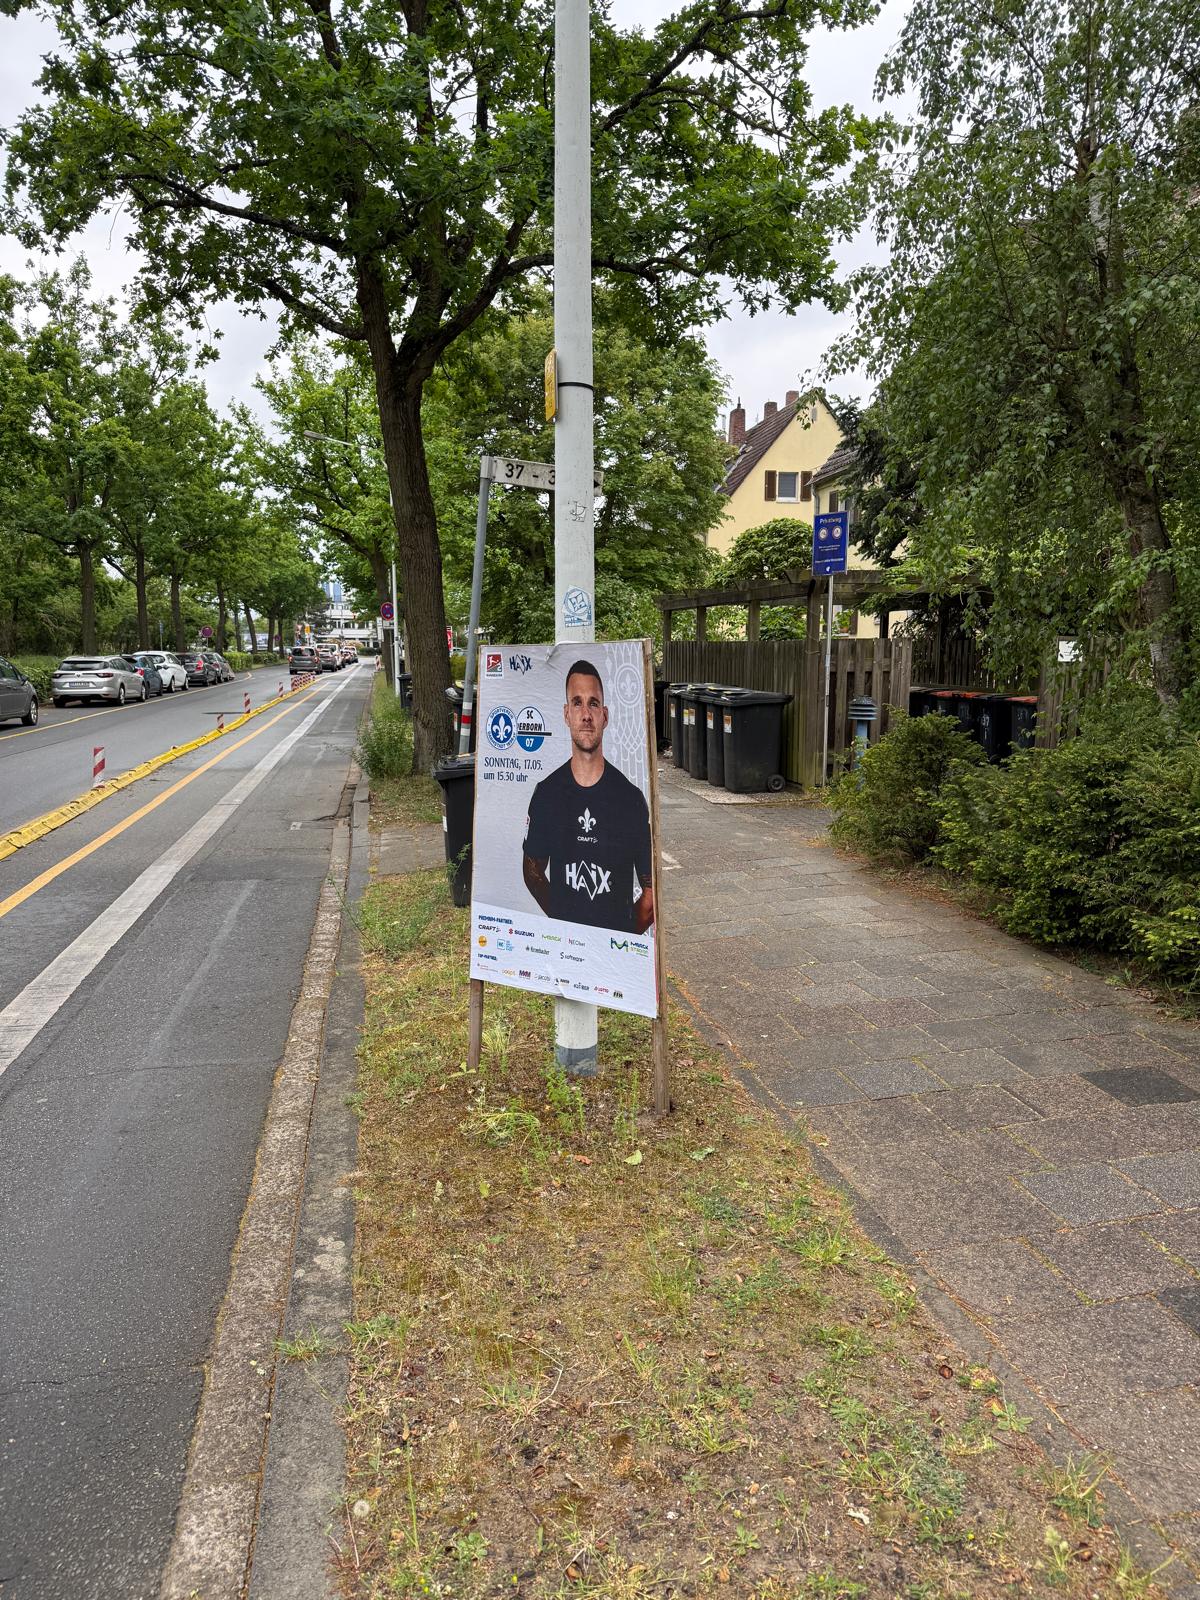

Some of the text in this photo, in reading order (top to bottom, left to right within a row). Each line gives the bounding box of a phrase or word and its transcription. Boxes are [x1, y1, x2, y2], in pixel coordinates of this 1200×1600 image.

[505, 463, 524, 479] 37
[548, 470, 555, 485] 3
[526, 710, 534, 719] SC
[525, 738, 535, 747] 07
[484, 757, 543, 770] SONNTAG, 17.05.
[484, 771, 528, 782] um 15.30 uhr
